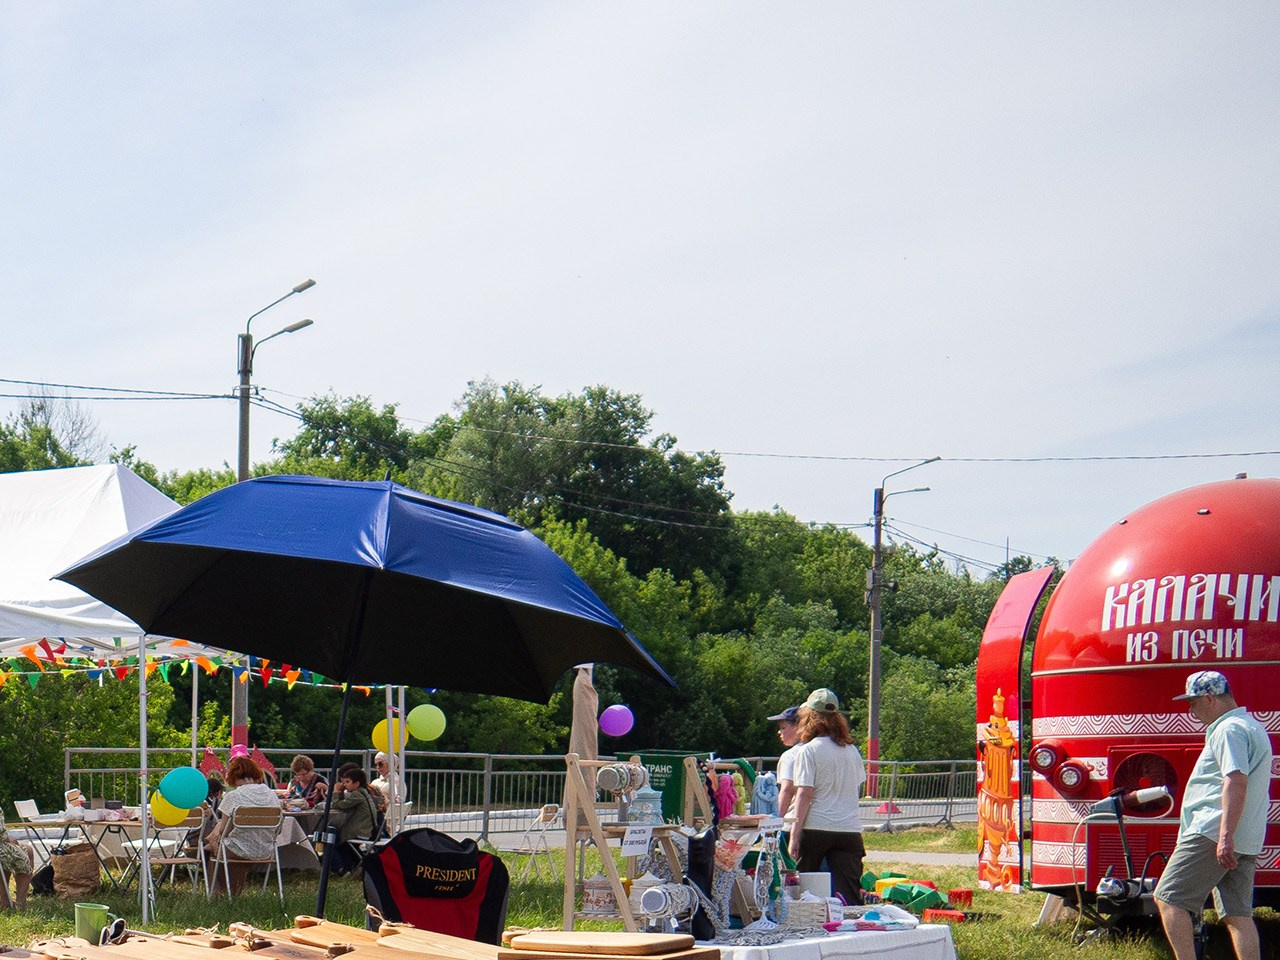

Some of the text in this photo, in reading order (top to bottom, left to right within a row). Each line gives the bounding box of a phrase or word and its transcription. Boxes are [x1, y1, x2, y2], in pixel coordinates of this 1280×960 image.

[1101, 573, 1280, 632] КАЛАЧИ
[1125, 627, 1244, 663] ИЗ ПЕЧИ
[415, 864, 477, 882] PRESIDENT
